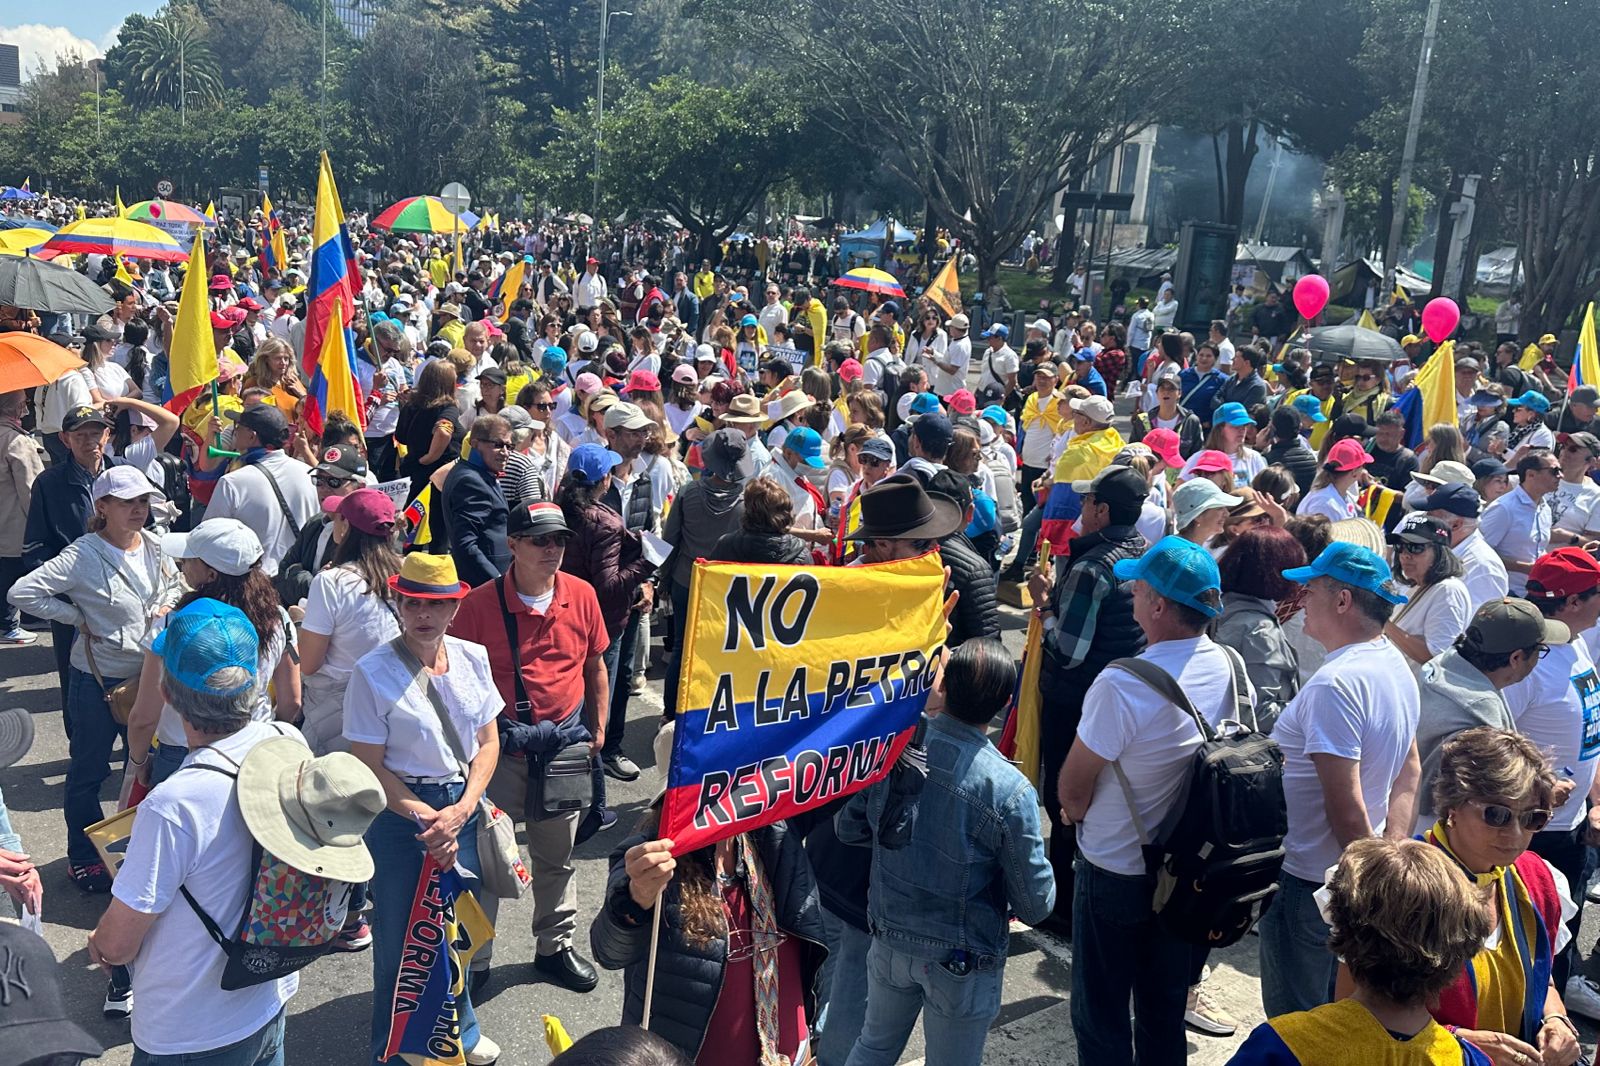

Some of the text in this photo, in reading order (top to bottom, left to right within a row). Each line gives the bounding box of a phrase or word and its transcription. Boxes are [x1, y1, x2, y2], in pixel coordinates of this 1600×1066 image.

[159, 183, 171, 192] 30
[415, 503, 425, 516] COL
[722, 573, 820, 652] NO
[704, 644, 945, 735] A LA PETRO
[694, 731, 897, 831] REFORMA
[392, 868, 446, 1015] EFORMA
